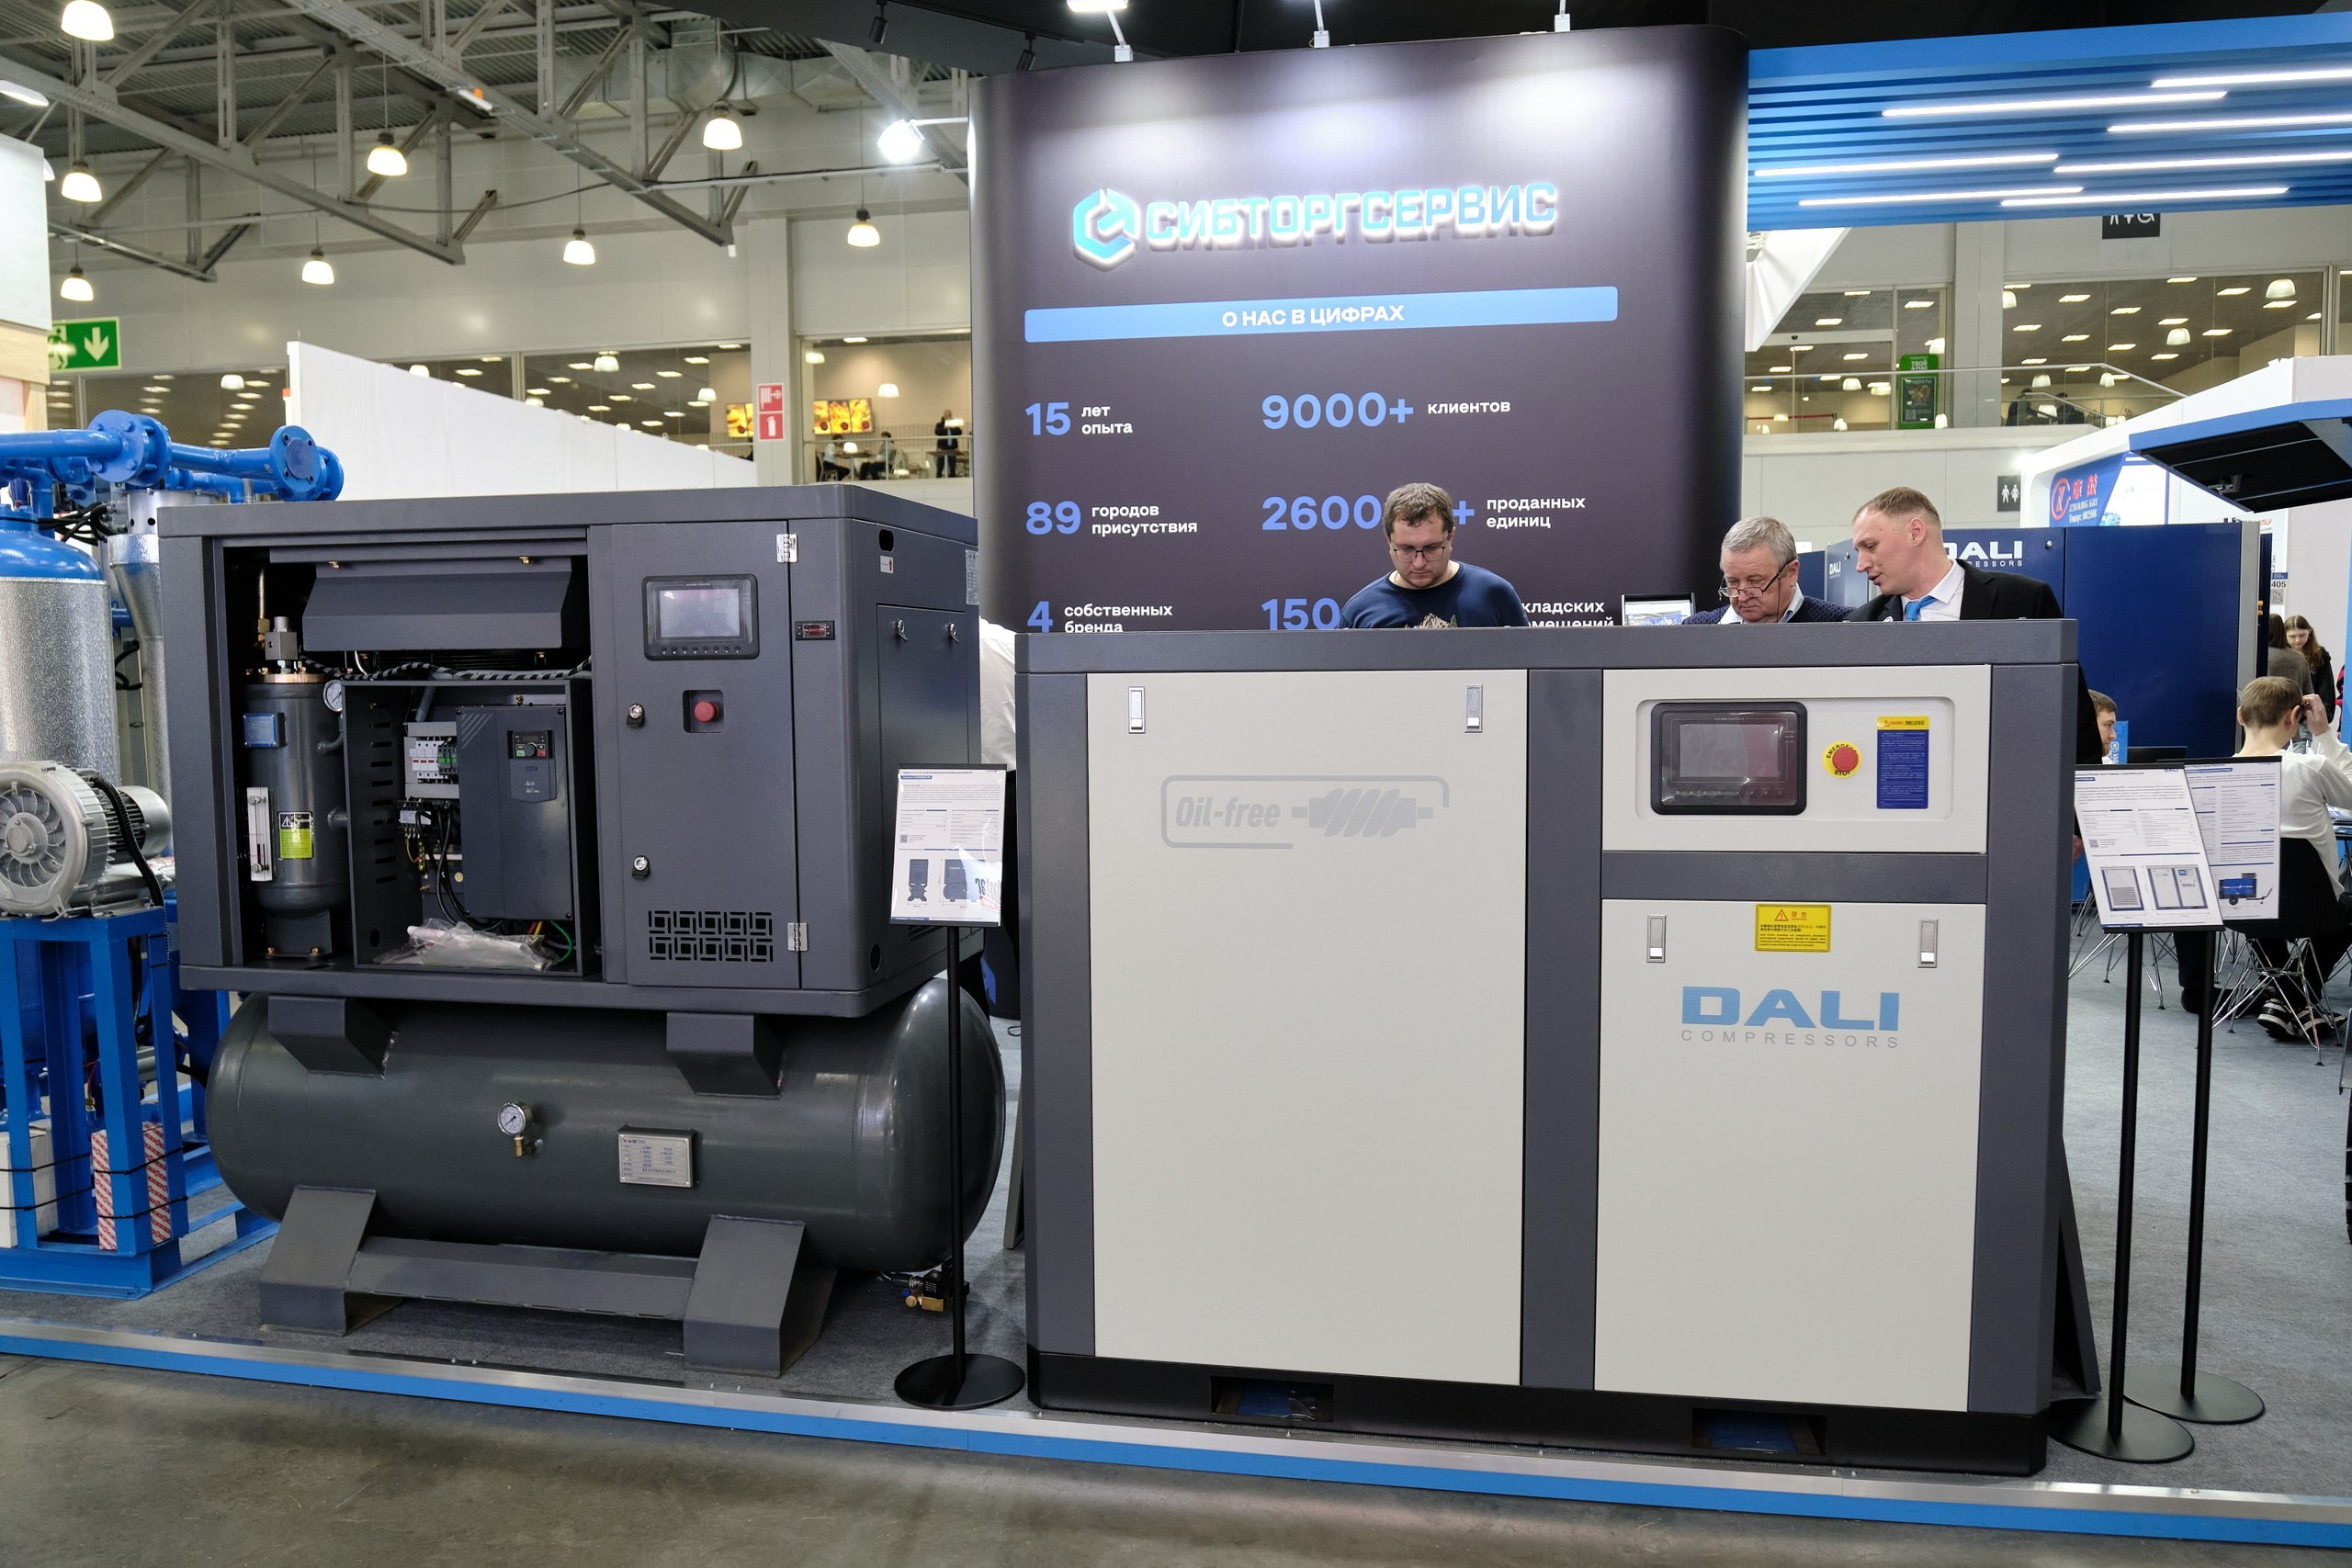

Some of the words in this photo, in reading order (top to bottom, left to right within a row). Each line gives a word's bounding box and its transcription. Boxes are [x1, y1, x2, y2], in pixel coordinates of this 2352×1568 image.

[1146, 183, 1559, 243] СИБТОРГСЕРВИС
[1222, 310, 1238, 327] О
[1242, 310, 1286, 327] НАС
[1291, 309, 1306, 325] В
[1309, 304, 1405, 327] ЦИФРАХ
[1081, 406, 1111, 417] лет
[1261, 391, 1414, 430] 9000+
[1427, 400, 1511, 414] клиентов
[1024, 401, 1071, 435] 15
[1081, 422, 1133, 434] опыта
[1091, 505, 1159, 520] городов
[1486, 496, 1586, 512] проданных
[1025, 501, 1081, 535] 89
[1486, 514, 1551, 529] единиц
[1091, 522, 1198, 536] присутствия
[1027, 601, 1053, 633] 4
[1064, 603, 1173, 616] собственных
[1521, 602, 1605, 615] кладских
[1175, 795, 1282, 828] Oil-free
[1681, 986, 1900, 1032] DALI
[1680, 1030, 1899, 1049] COMPRESSORS
